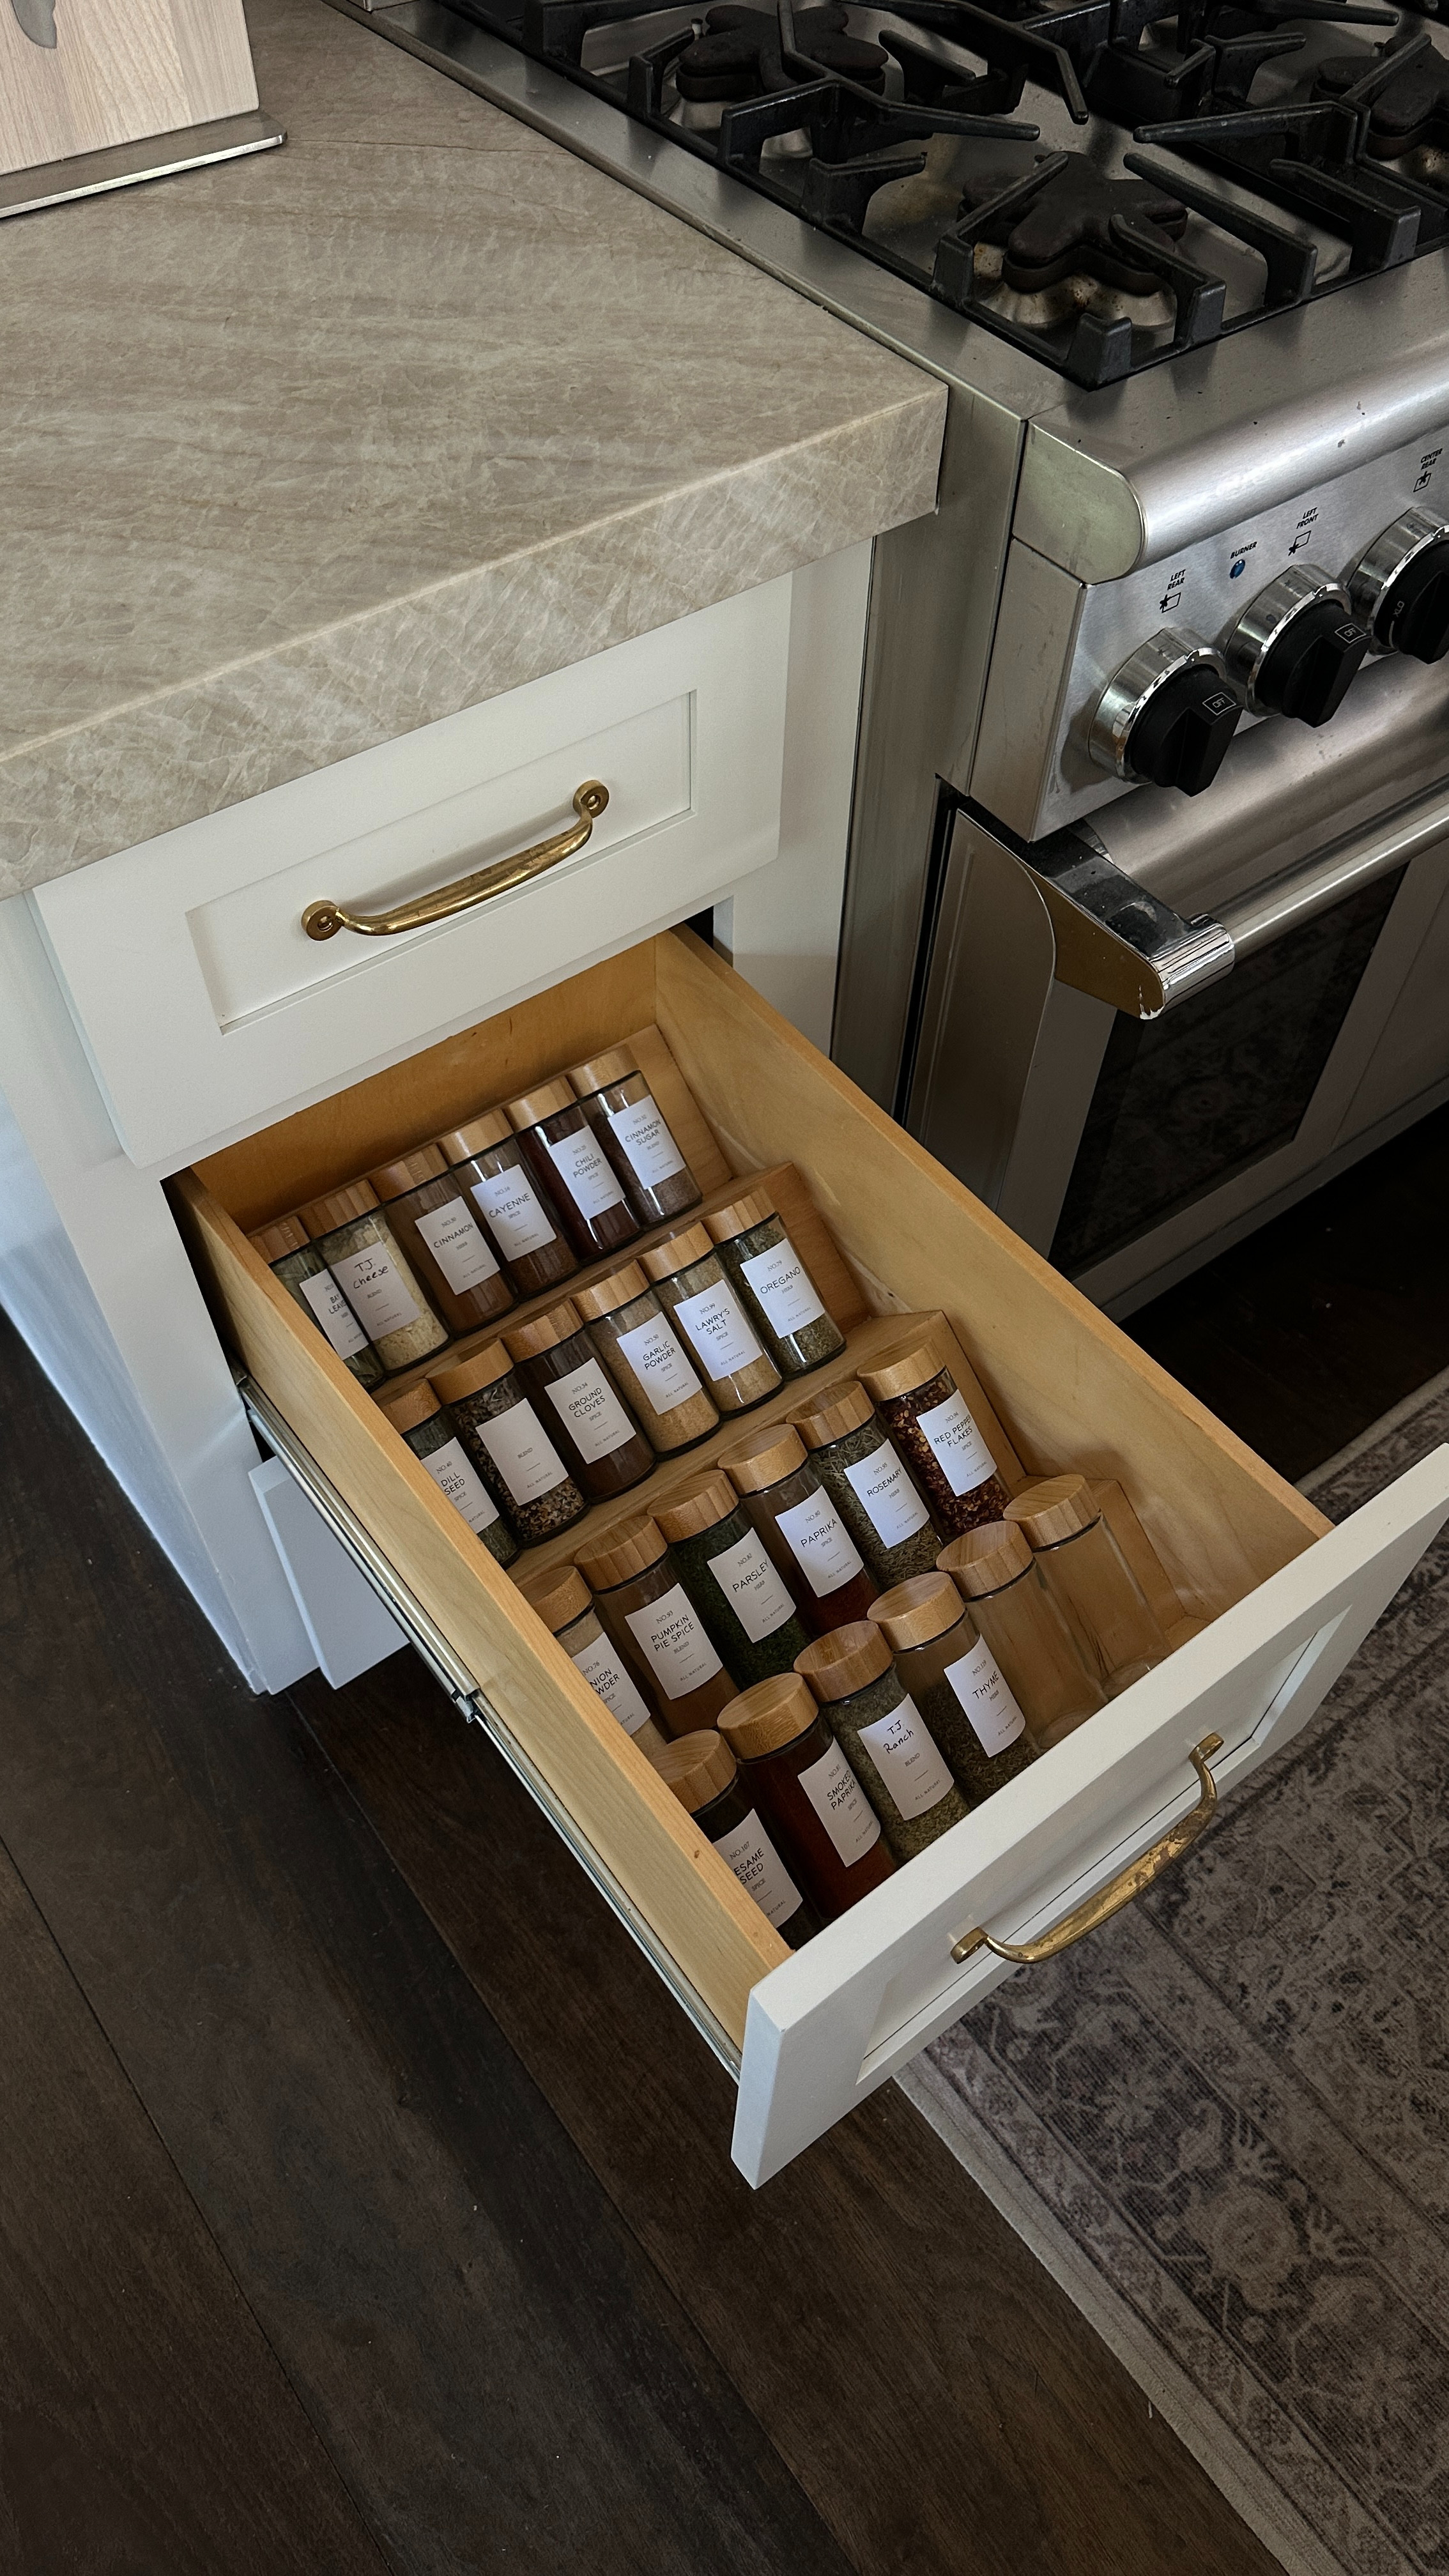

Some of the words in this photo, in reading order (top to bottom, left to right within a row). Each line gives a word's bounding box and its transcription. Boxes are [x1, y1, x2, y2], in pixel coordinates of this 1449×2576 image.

[1421, 448, 1443, 463] CENTER
[1421, 457, 1436, 470] REAR
[1296, 514, 1319, 529] FRONT
[1303, 507, 1317, 519] LEFT
[1230, 541, 1257, 559] BURNER
[1167, 578, 1185, 590] REAR
[1170, 569, 1186, 581] LEFT
[1344, 627, 1356, 637] OFF
[1213, 697, 1225, 709] OFF
[625, 1119, 662, 1142] CINNAMON
[636, 1130, 660, 1146] SUGAR
[573, 1158, 602, 1178] POWDER
[576, 1153, 595, 1167] CHILI
[489, 1193, 531, 1218] CAYENNE
[434, 1222, 474, 1248] CINNAMON
[353, 1266, 389, 1289] Cheese
[760, 1266, 801, 1294] OREGANO
[695, 1308, 731, 1331] LAWRY'S
[706, 1319, 727, 1335] SALT
[643, 1340, 670, 1361] GARLIC
[645, 1347, 676, 1370] POWDER
[569, 1387, 602, 1411] GROUND
[574, 1395, 606, 1418] CLOVES
[934, 1432, 951, 1445] RED
[952, 1414, 972, 1434] PEPPER
[947, 1426, 972, 1447] FLAKES
[517, 1447, 533, 1459] BLEND
[441, 1472, 461, 1487] DILL
[444, 1478, 465, 1496] SEED
[535, 1471, 553, 1484] NATURAL
[867, 1467, 903, 1498] ROSEMARY
[801, 1518, 838, 1548] PAPRIKA
[732, 1560, 770, 1593] PARSLEY
[656, 1610, 674, 1624] NO.93
[650, 1614, 690, 1643] PUMPKIN
[654, 1639, 670, 1652] PIE
[671, 1621, 695, 1643] SPICE
[673, 1641, 690, 1653] BLEND
[582, 1660, 601, 1676] NO.76
[688, 1662, 708, 1677] NATURAL
[590, 1668, 612, 1689] NION
[595, 1674, 620, 1695] WDER
[972, 1671, 1000, 1699] THYME
[620, 1713, 635, 1725] ATURAL
[883, 1729, 914, 1754] Ranch
[905, 1752, 920, 1767] BLEND
[827, 1770, 851, 1801] SMOKED
[831, 1779, 855, 1811] PAPRIKA
[729, 1841, 750, 1860] NO.107
[733, 1848, 764, 1876] ESAME
[739, 1863, 763, 1885] SEED
[752, 1878, 766, 1891] SPICE
